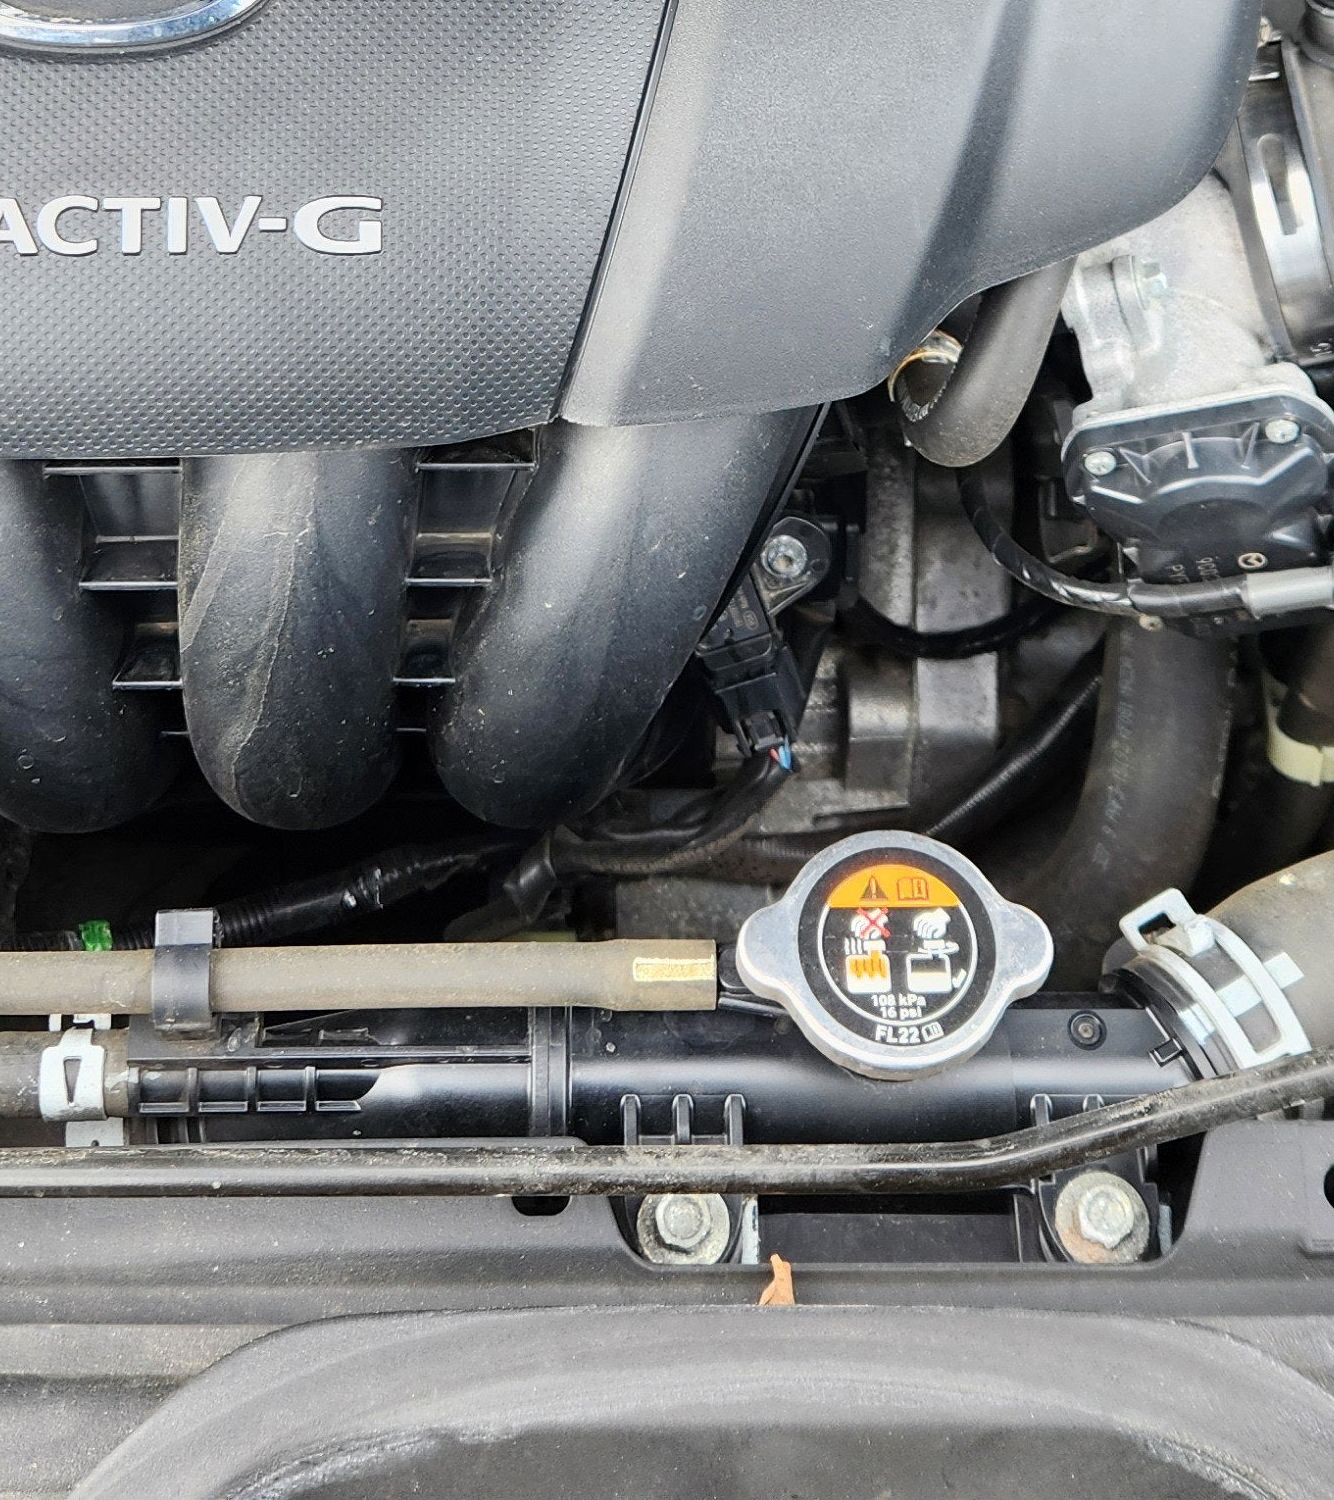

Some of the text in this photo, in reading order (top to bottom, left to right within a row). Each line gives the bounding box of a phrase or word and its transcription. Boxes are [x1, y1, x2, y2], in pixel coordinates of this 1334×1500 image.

[871, 993, 927, 1007] 108 kPa
[880, 1006, 923, 1020] 16 psi
[875, 1024, 921, 1044] FL22
